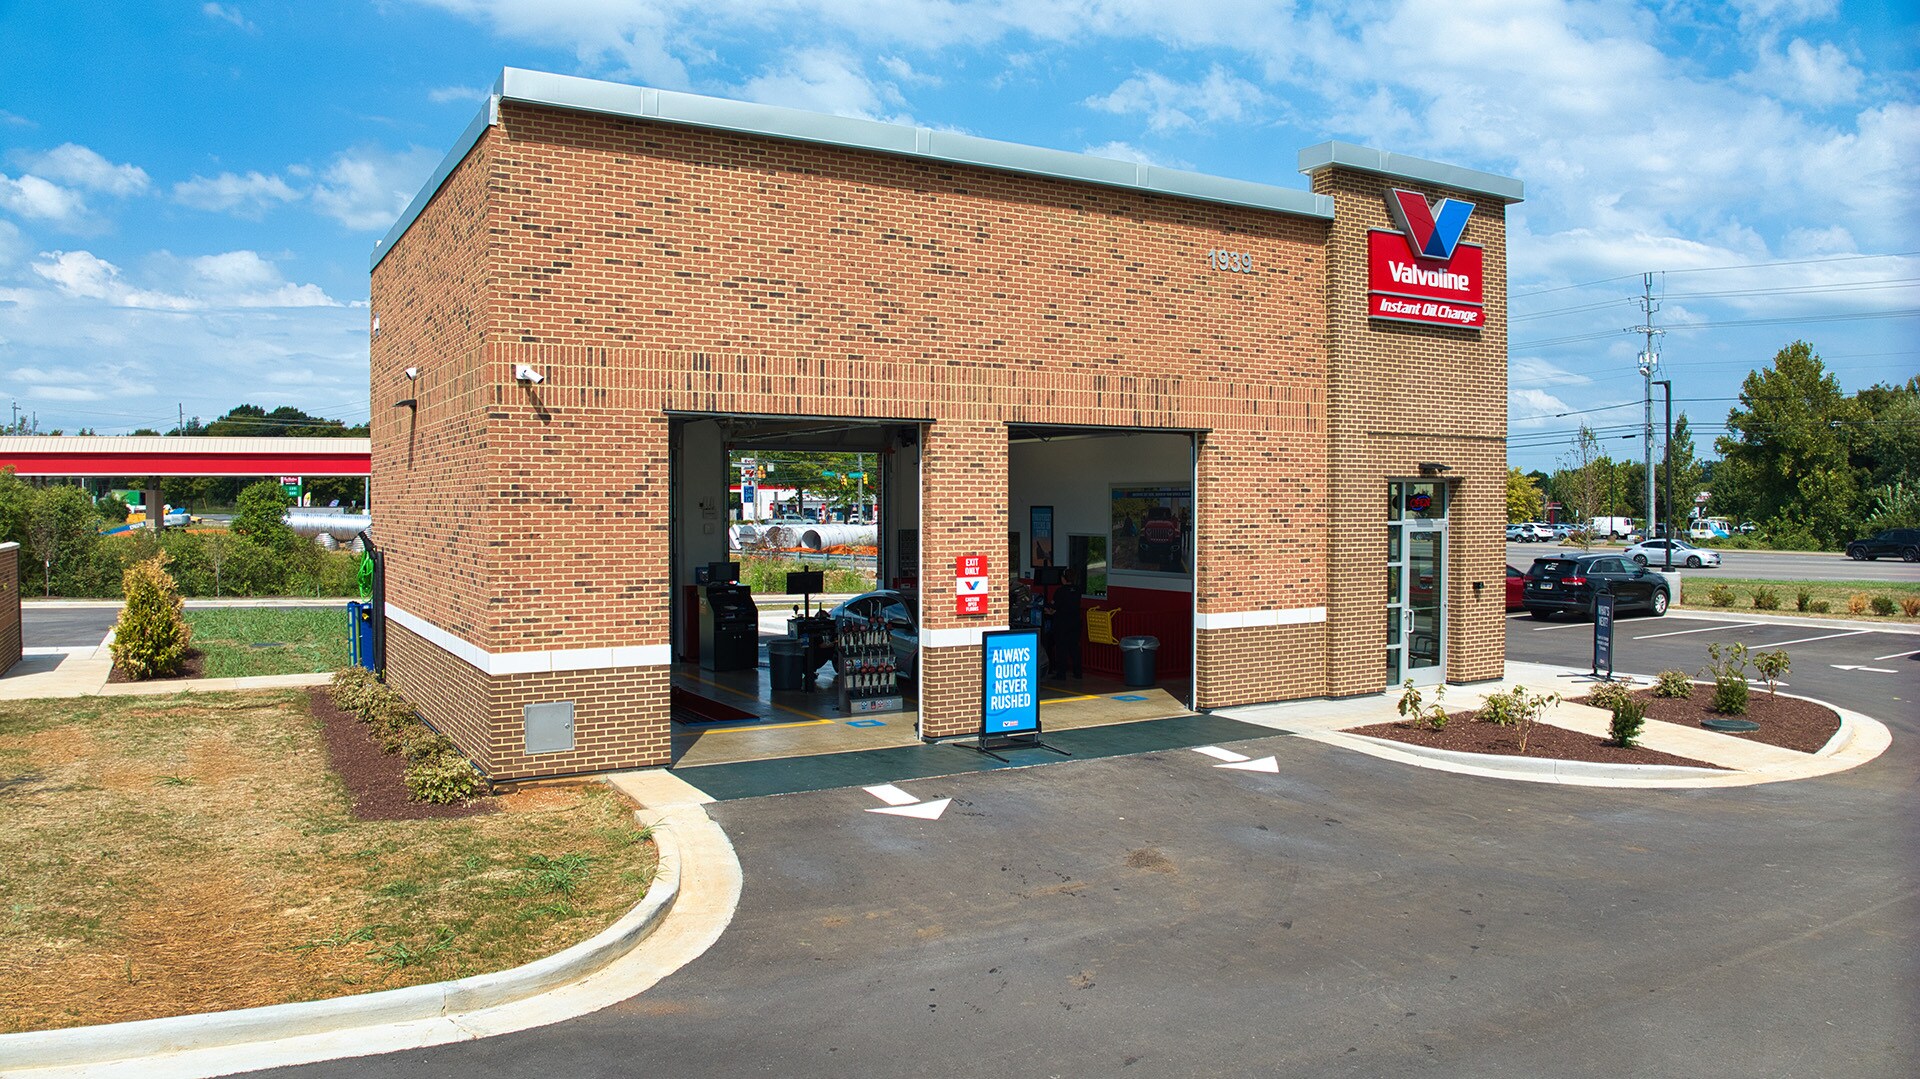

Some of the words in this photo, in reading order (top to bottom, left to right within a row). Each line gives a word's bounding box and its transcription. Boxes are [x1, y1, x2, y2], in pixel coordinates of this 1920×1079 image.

[1208, 248, 1252, 274] 1939
[1388, 261, 1470, 291] Valvoline
[1380, 299, 1421, 315] Instant
[1422, 303, 1438, 317] Oil
[1438, 305, 1478, 323] Change
[965, 558, 979, 566] EXIT
[965, 567, 980, 575] ONLY
[992, 648, 1031, 664] ALWAYS
[995, 663, 1027, 679] QUICK
[995, 678, 1028, 694] NEVER
[991, 694, 1031, 710] RUSHED
